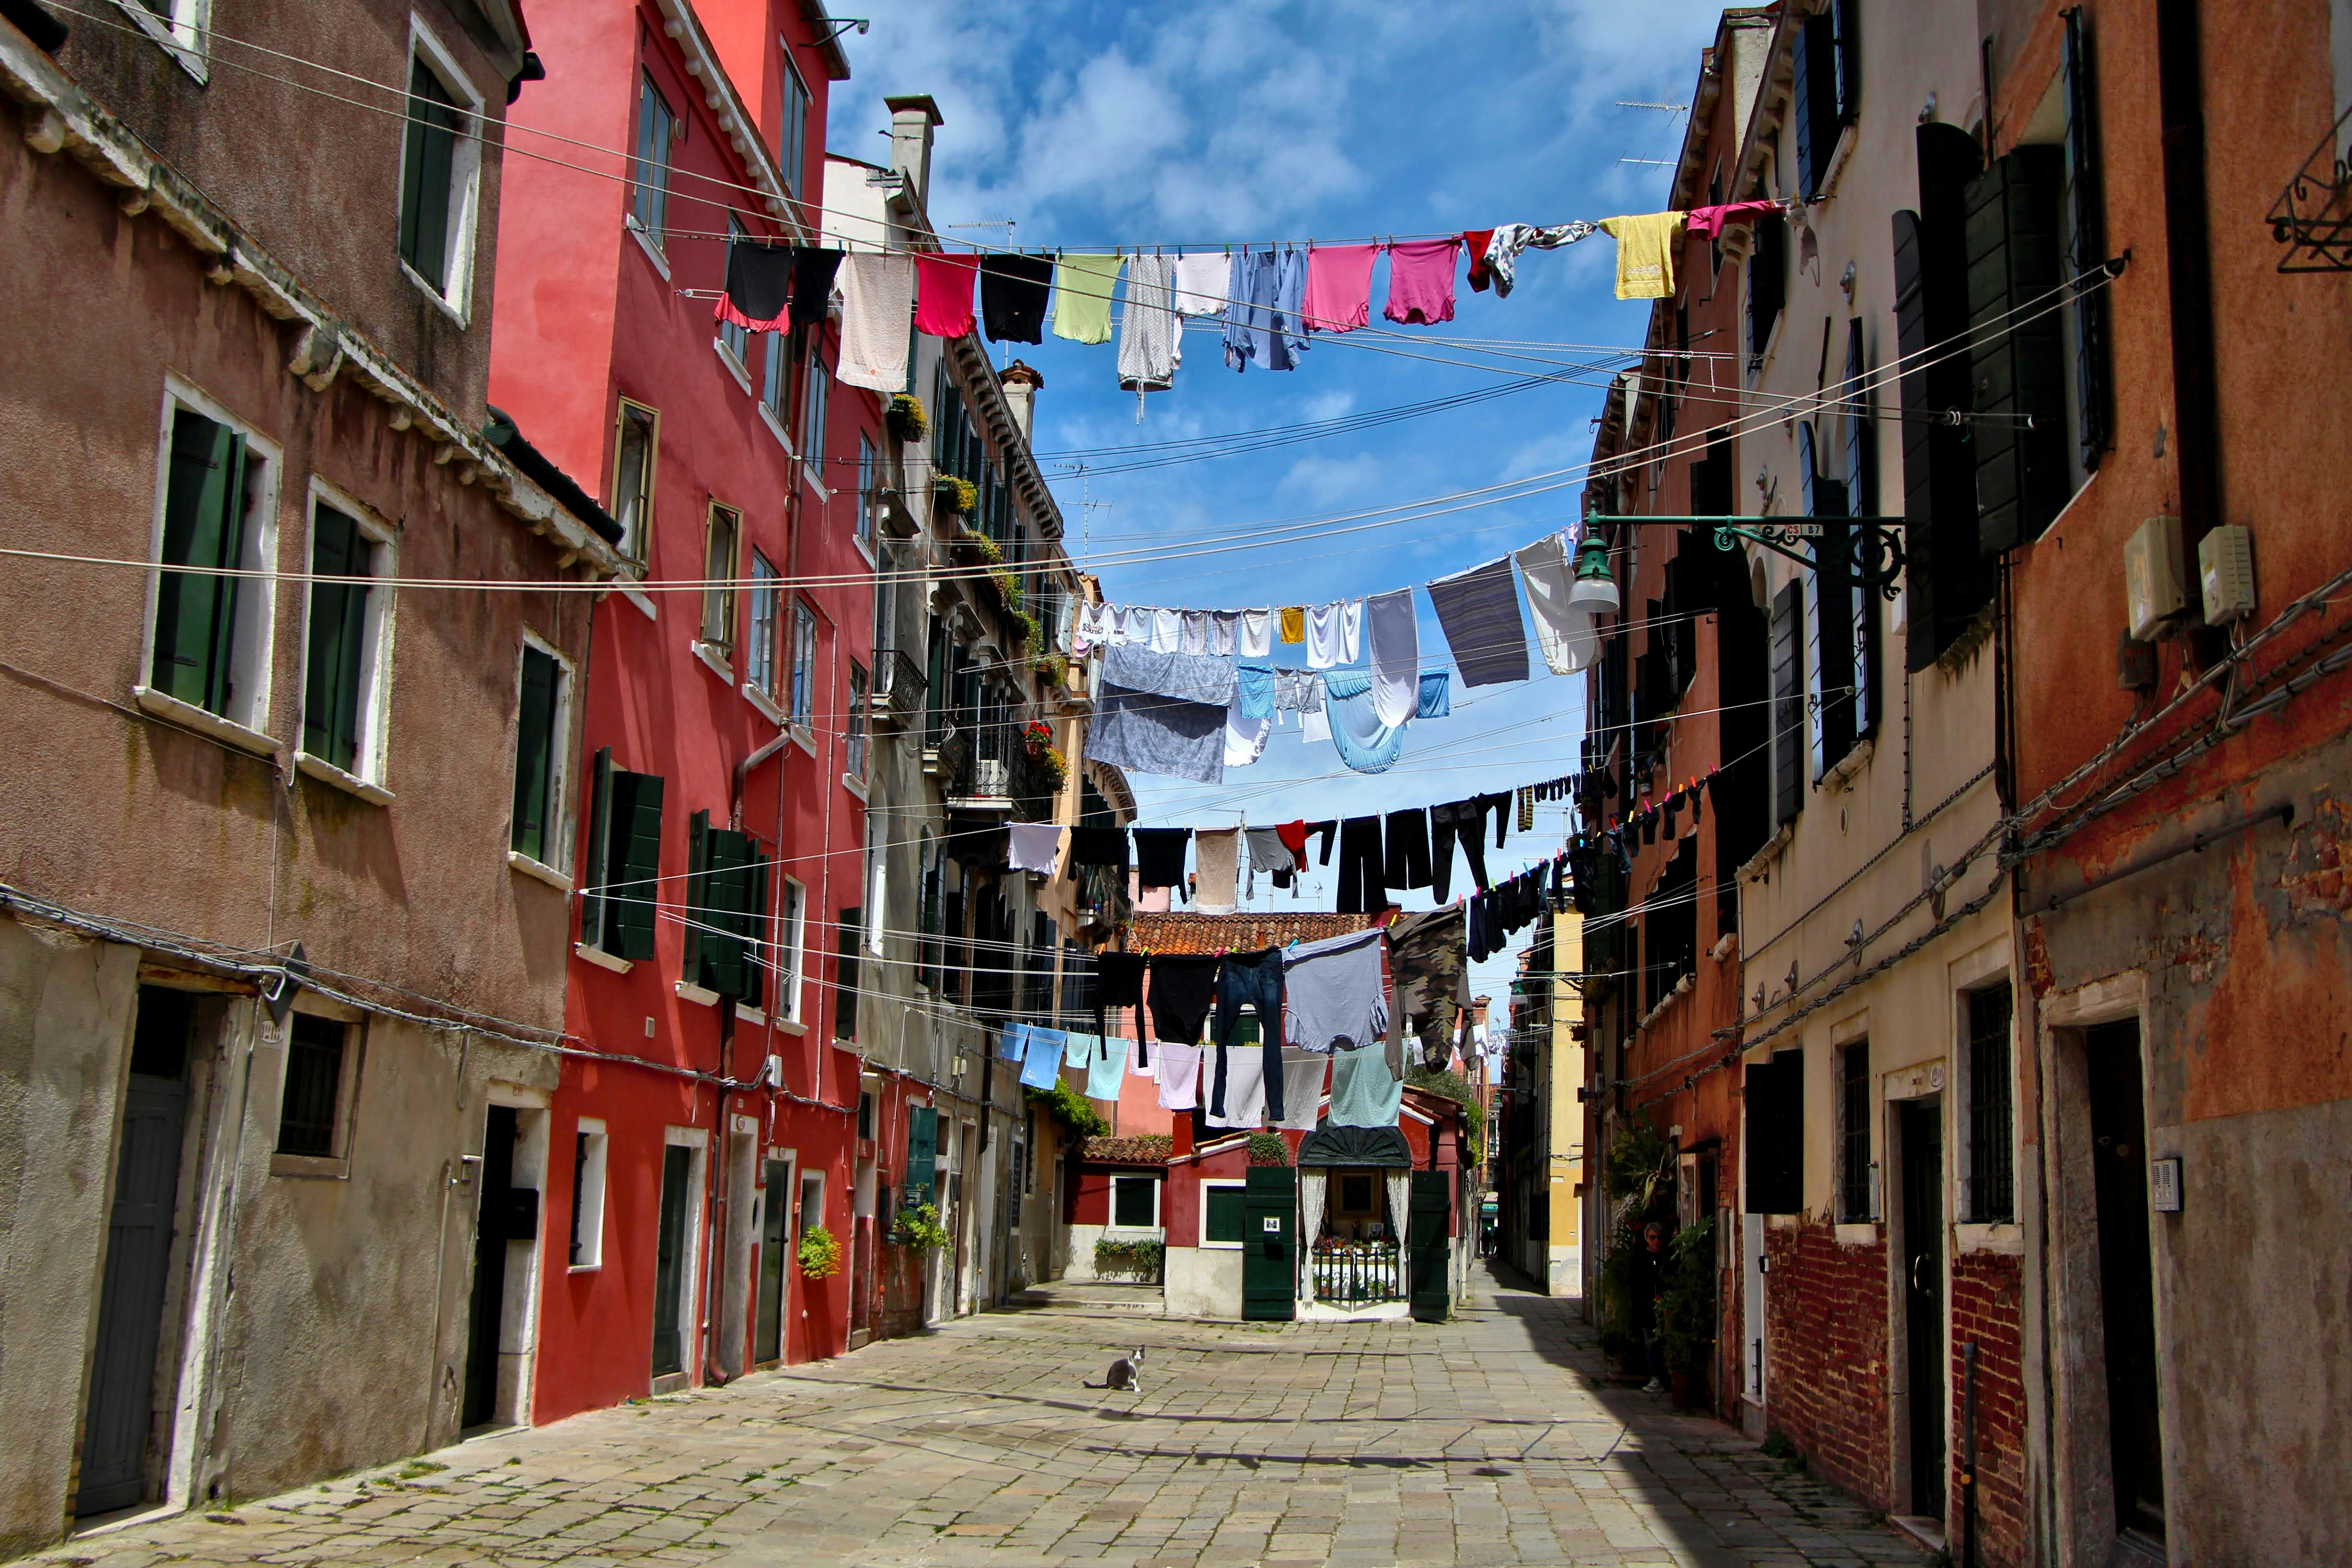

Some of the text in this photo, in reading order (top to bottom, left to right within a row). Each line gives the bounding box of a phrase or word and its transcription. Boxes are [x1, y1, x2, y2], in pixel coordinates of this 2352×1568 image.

[1788, 525, 1819, 534] CS B7
[1082, 623, 1103, 634] CELTICS
